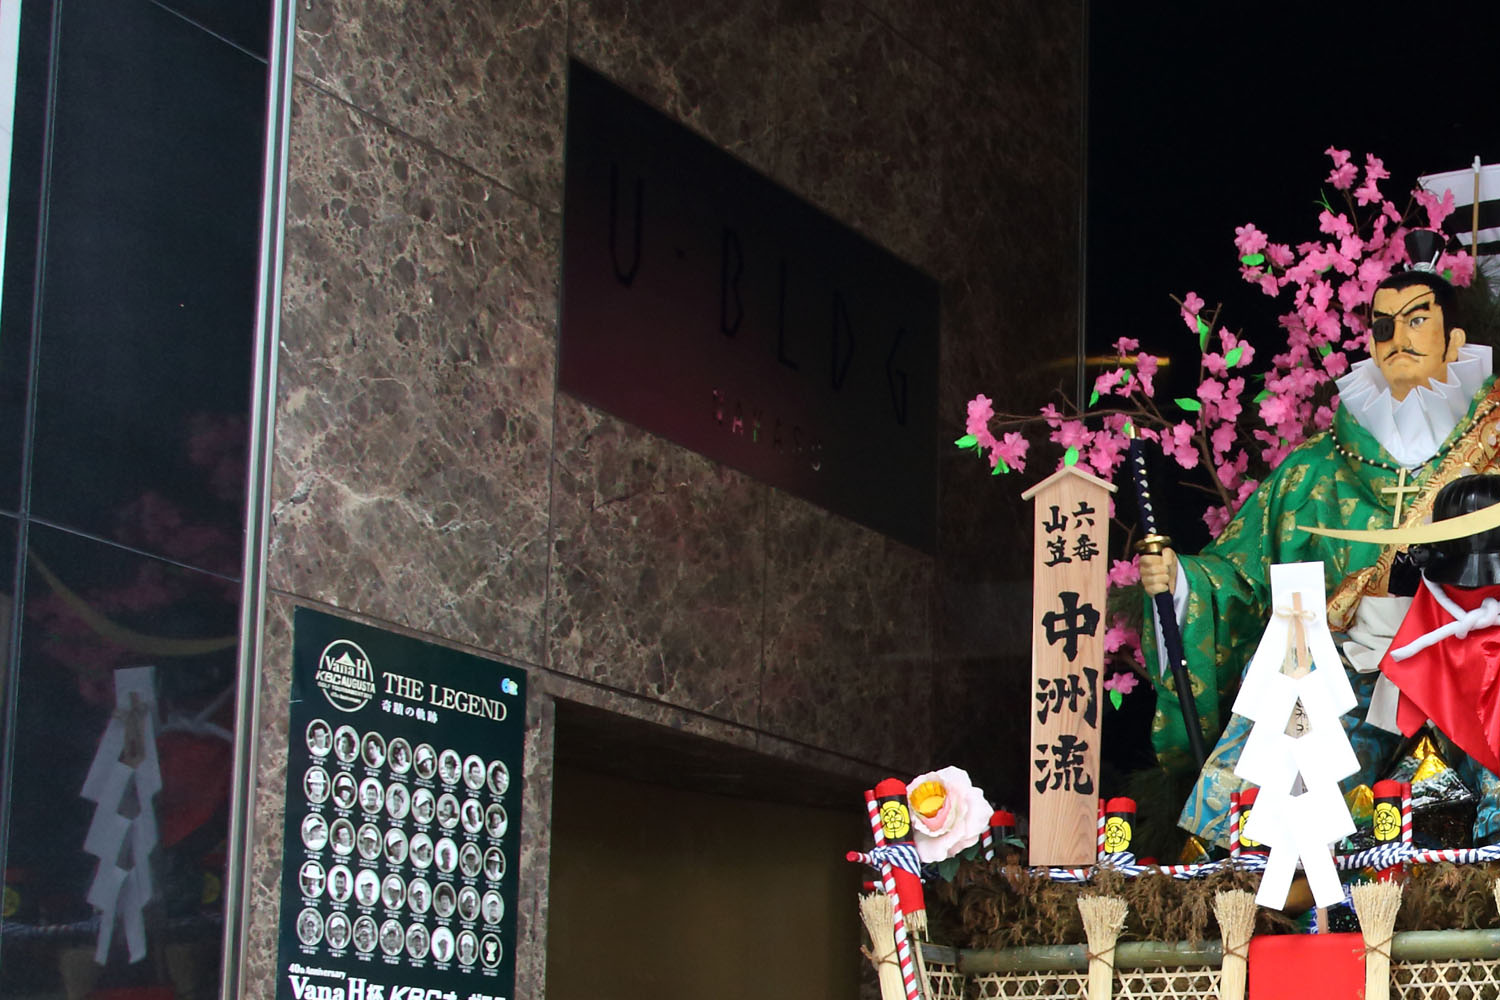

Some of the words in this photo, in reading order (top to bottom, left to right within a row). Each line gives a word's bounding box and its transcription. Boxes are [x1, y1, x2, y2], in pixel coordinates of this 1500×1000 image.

[1042, 505, 1072, 567] 山笠
[1071, 501, 1100, 563] 六番
[325, 655, 367, 680] VanaH
[382, 671, 425, 701] THE
[429, 683, 508, 722] LEGEND
[1035, 591, 1101, 795] 中洲流
